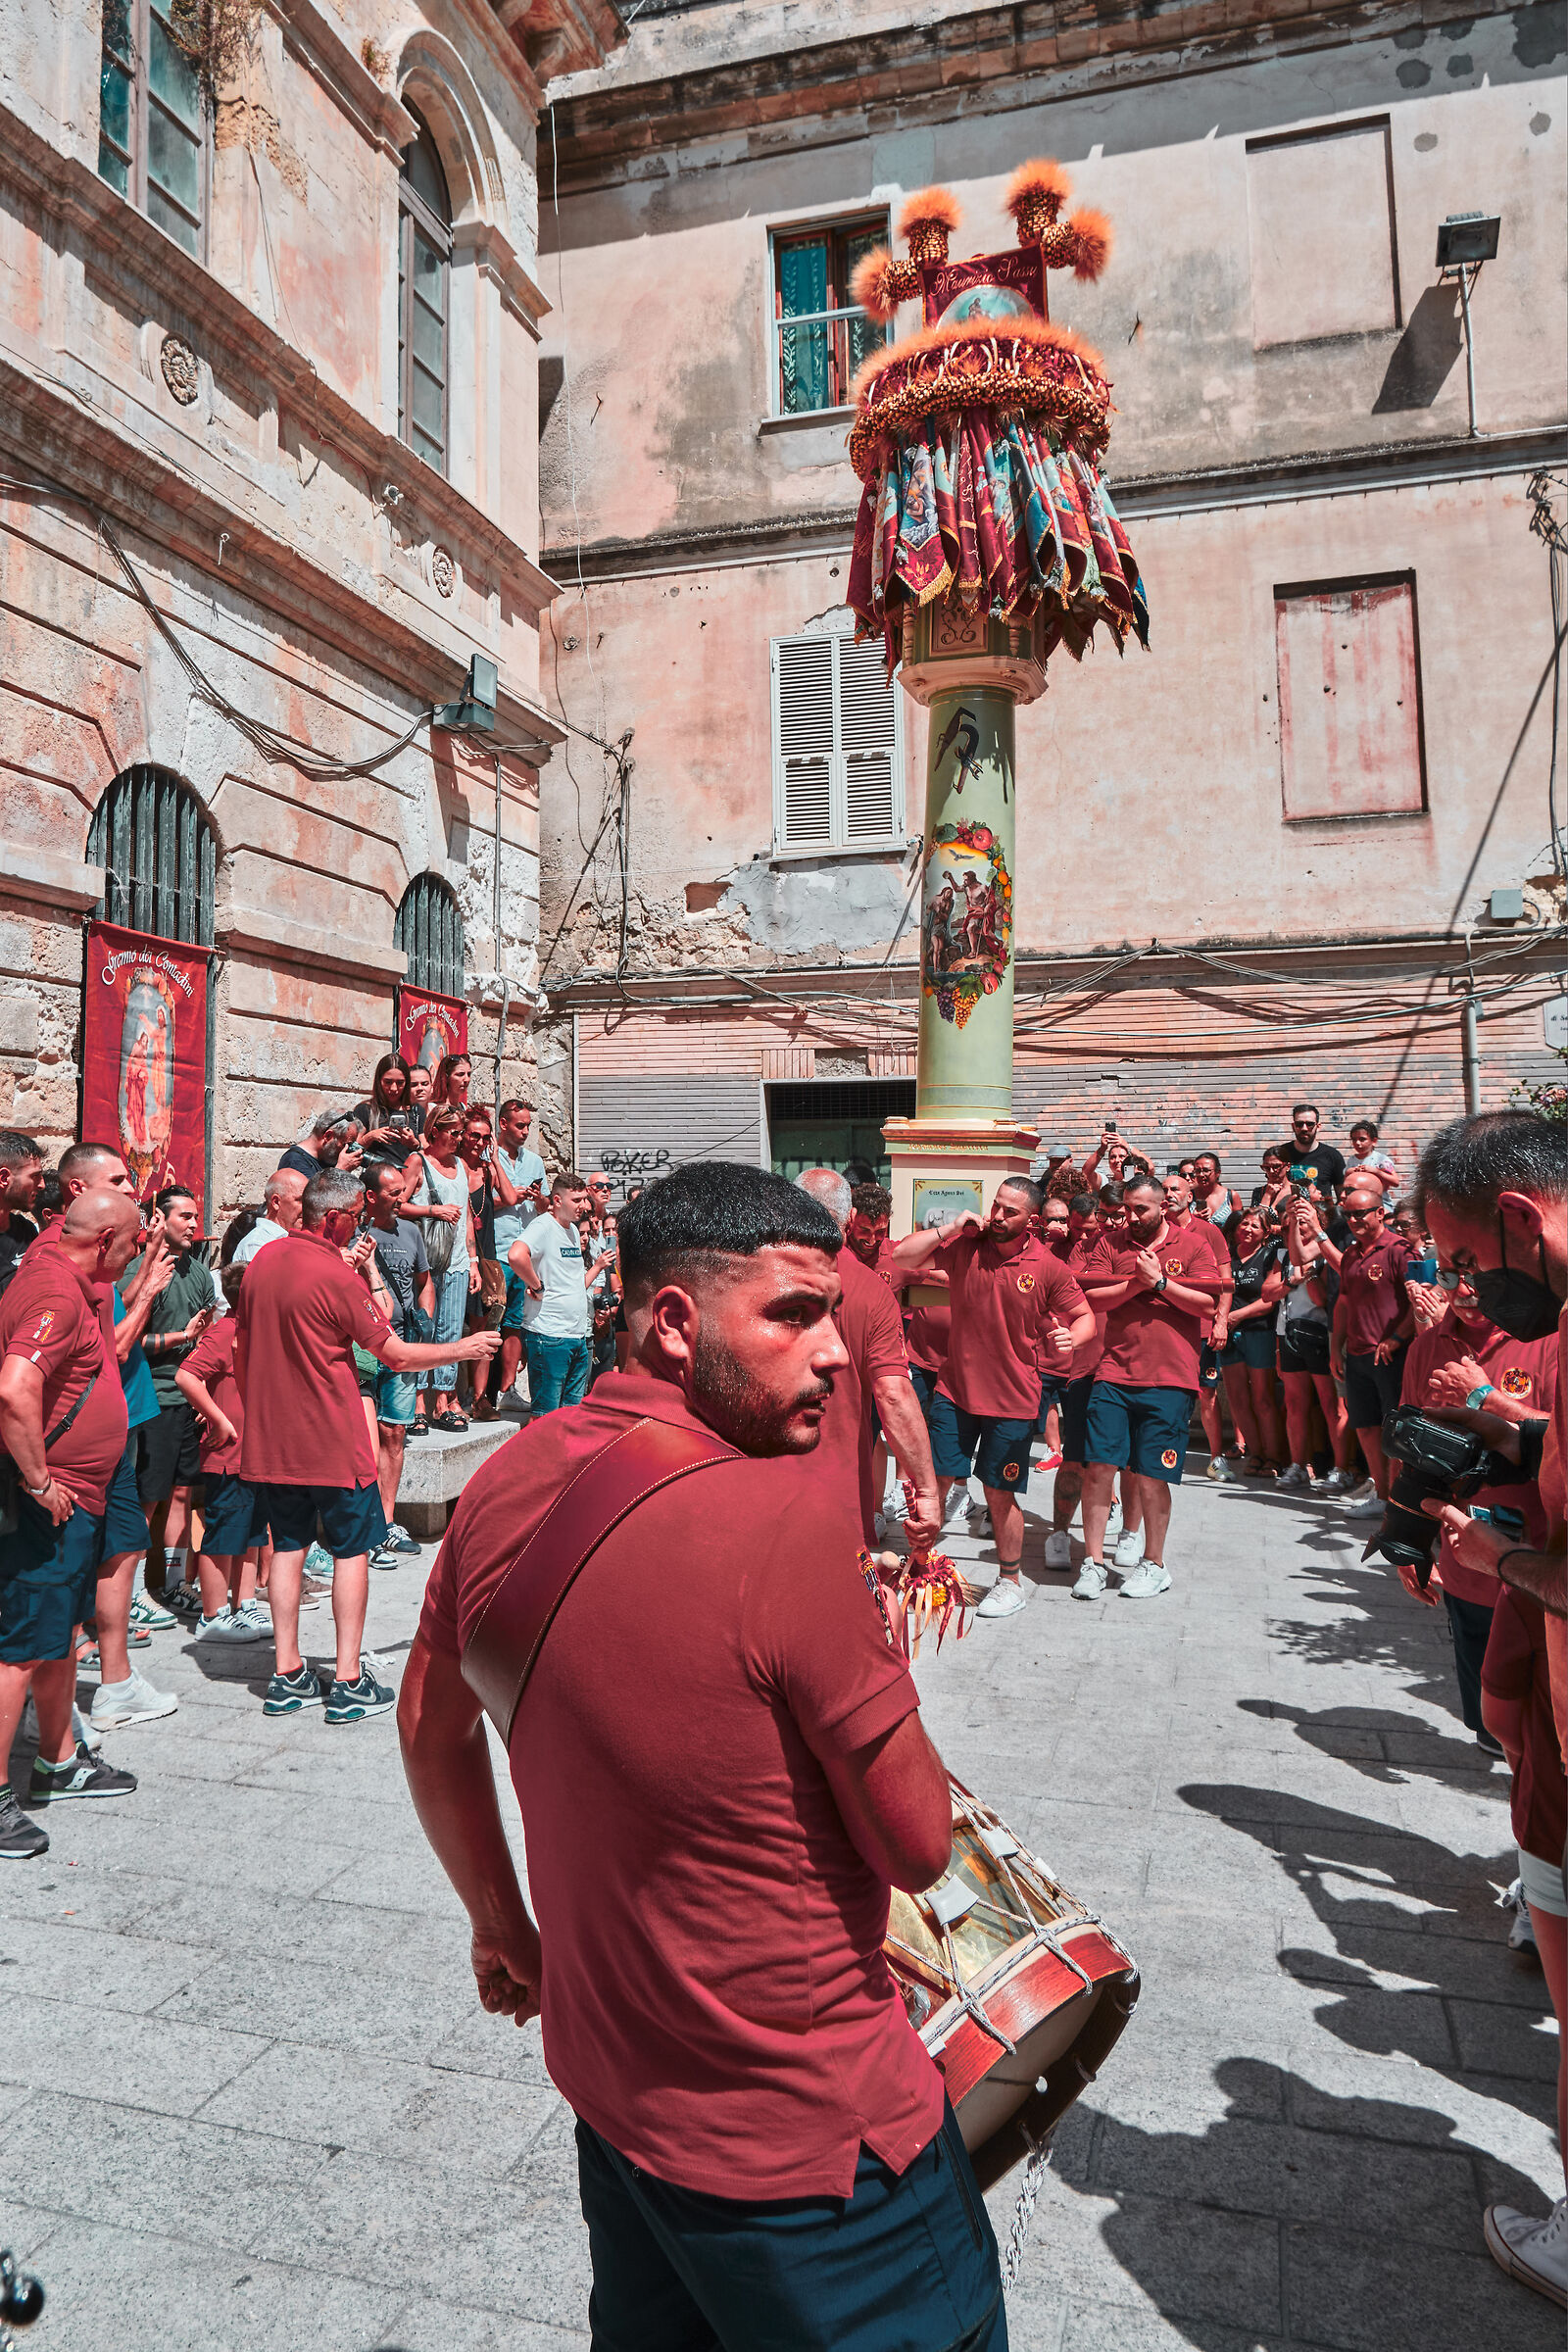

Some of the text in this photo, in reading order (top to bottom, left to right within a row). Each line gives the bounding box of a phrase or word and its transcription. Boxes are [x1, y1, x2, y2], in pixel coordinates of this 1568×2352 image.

[930, 269, 995, 296] Maurizio
[101, 944, 195, 998] Gremio dei Contadini
